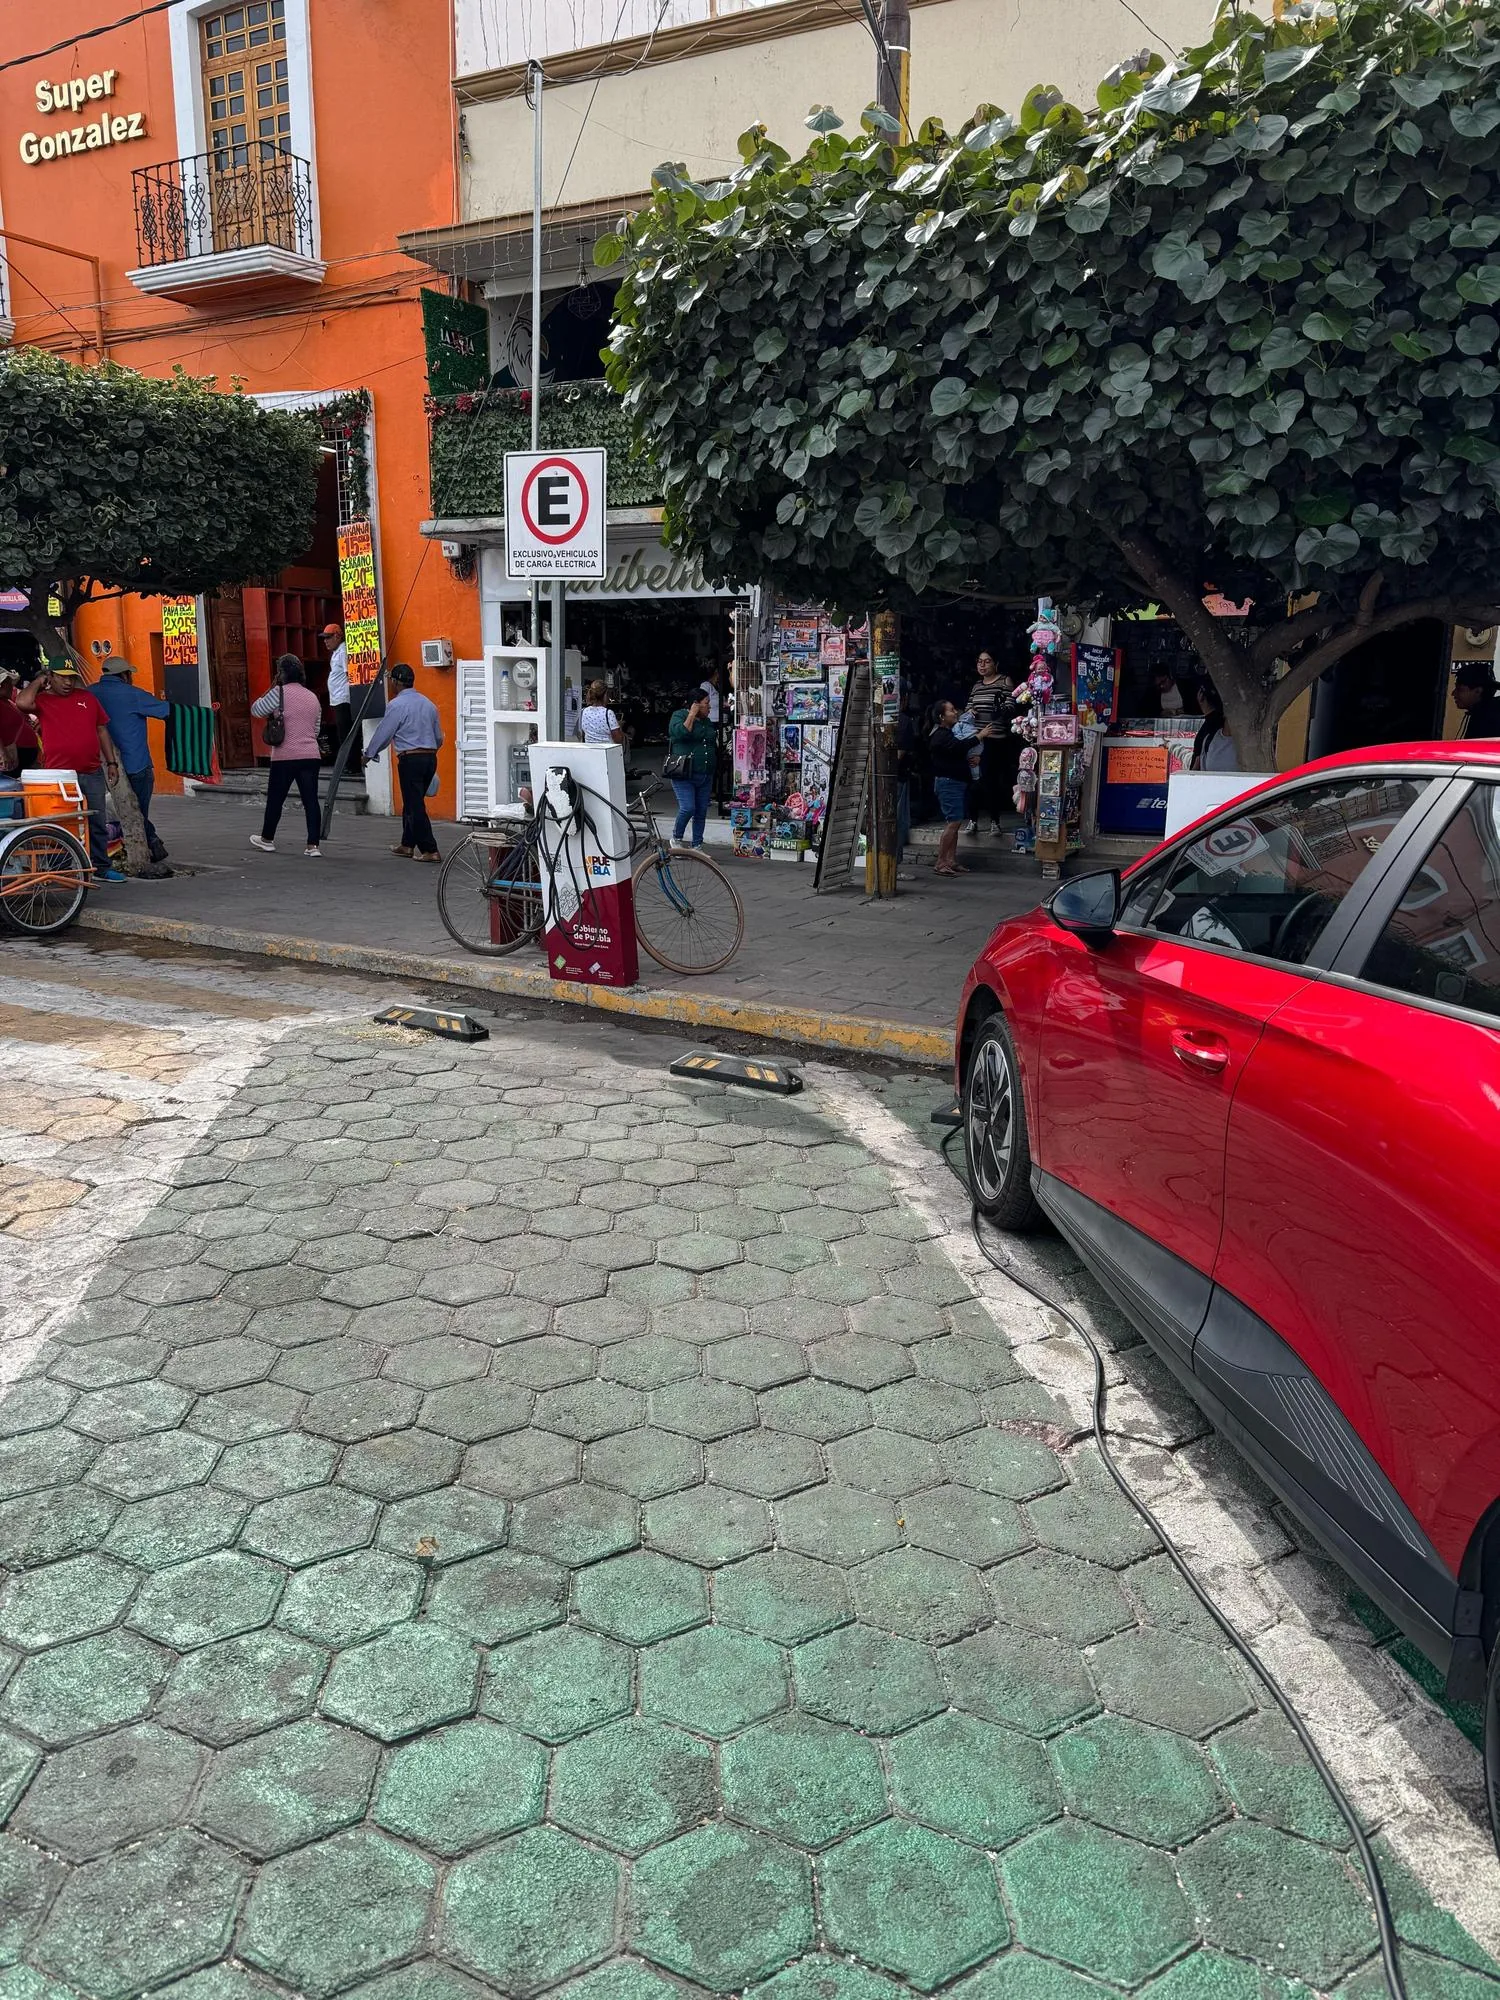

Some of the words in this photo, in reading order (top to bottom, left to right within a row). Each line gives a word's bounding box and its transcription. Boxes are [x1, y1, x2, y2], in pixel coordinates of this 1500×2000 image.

[35, 69, 118, 113] Super
[19, 112, 147, 165] Gonzalez
[538, 476, 570, 525] E
[513, 550, 554, 558] EXCLUSIVO
[557, 550, 598, 558] VEHICULOS
[340, 555, 371, 571] SERRANO
[515, 560, 525, 568] DE
[526, 560, 552, 568] CARGA
[555, 560, 597, 568] ELECTRICA
[591, 856, 610, 866] PUE
[592, 866, 611, 876] BLA
[584, 933, 611, 942] Publa
